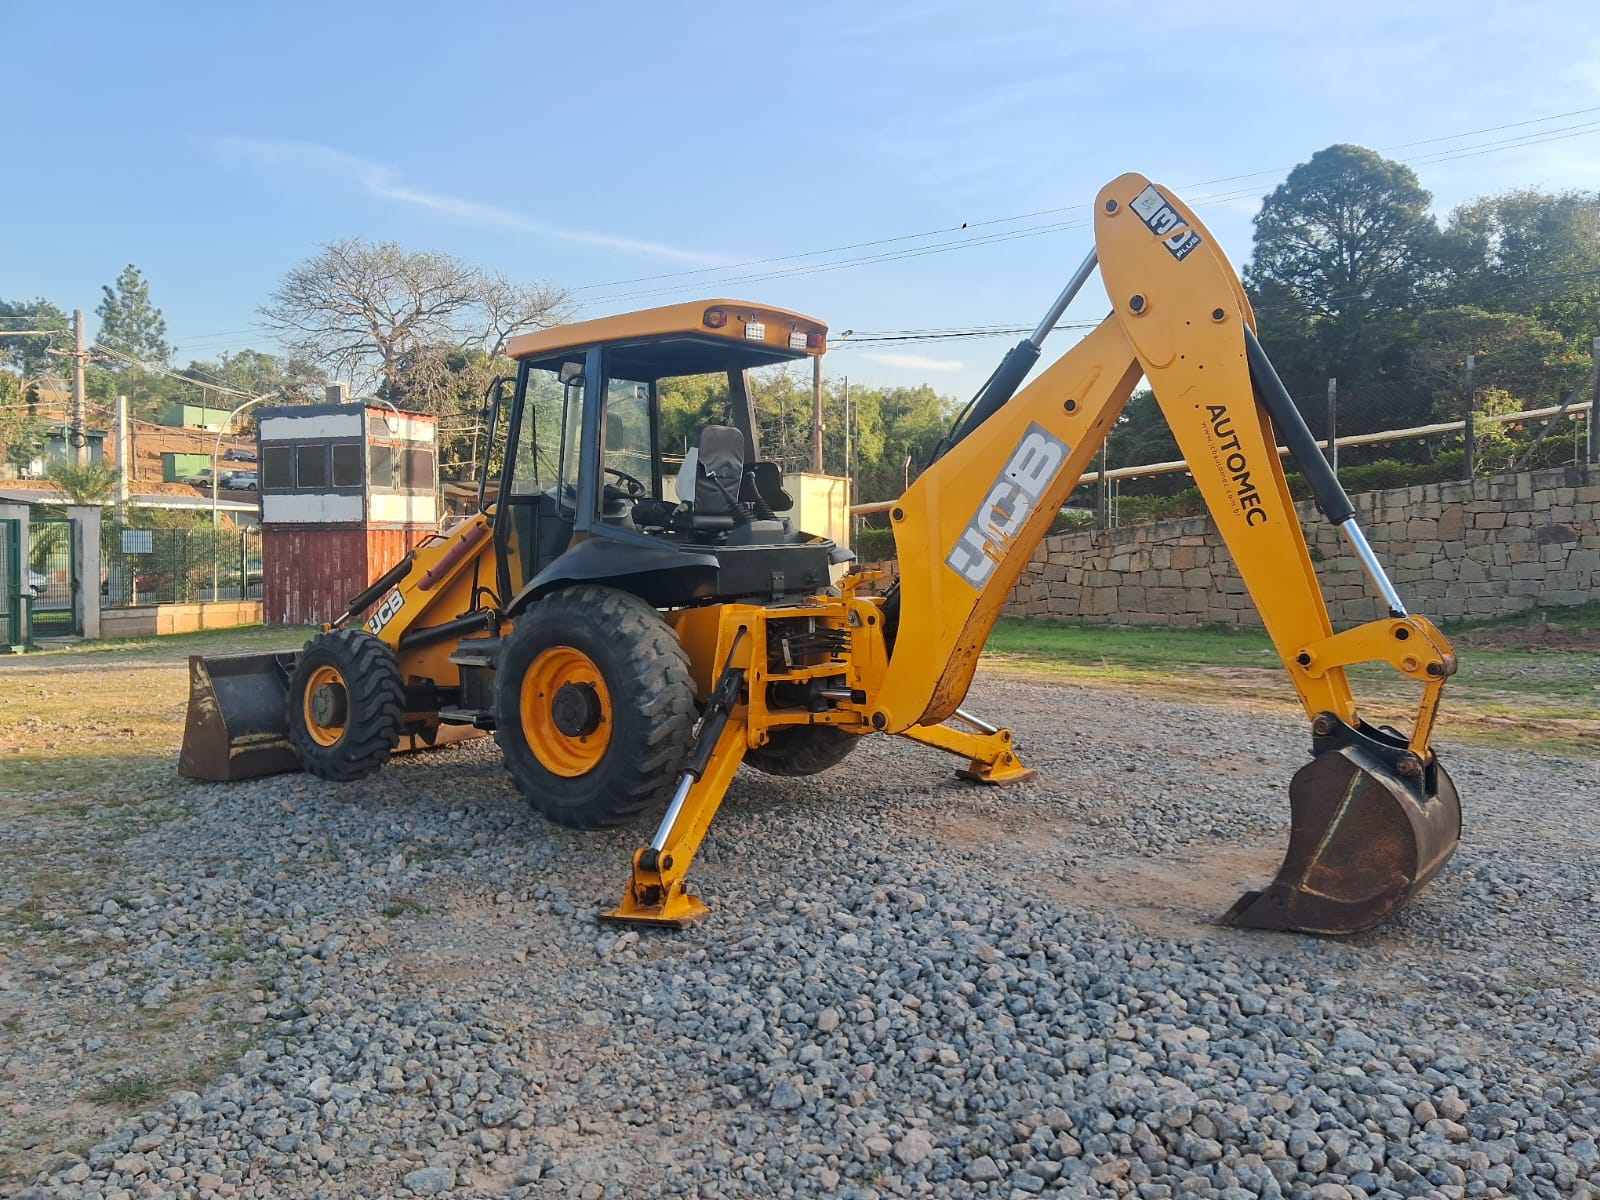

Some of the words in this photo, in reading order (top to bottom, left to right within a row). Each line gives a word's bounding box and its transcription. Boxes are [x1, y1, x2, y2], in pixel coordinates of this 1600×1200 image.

[1176, 236, 1200, 258] PLUS
[949, 432, 1062, 582] JCB
[1205, 405, 1267, 526] AUTOMEC
[368, 589, 404, 635] JCB
